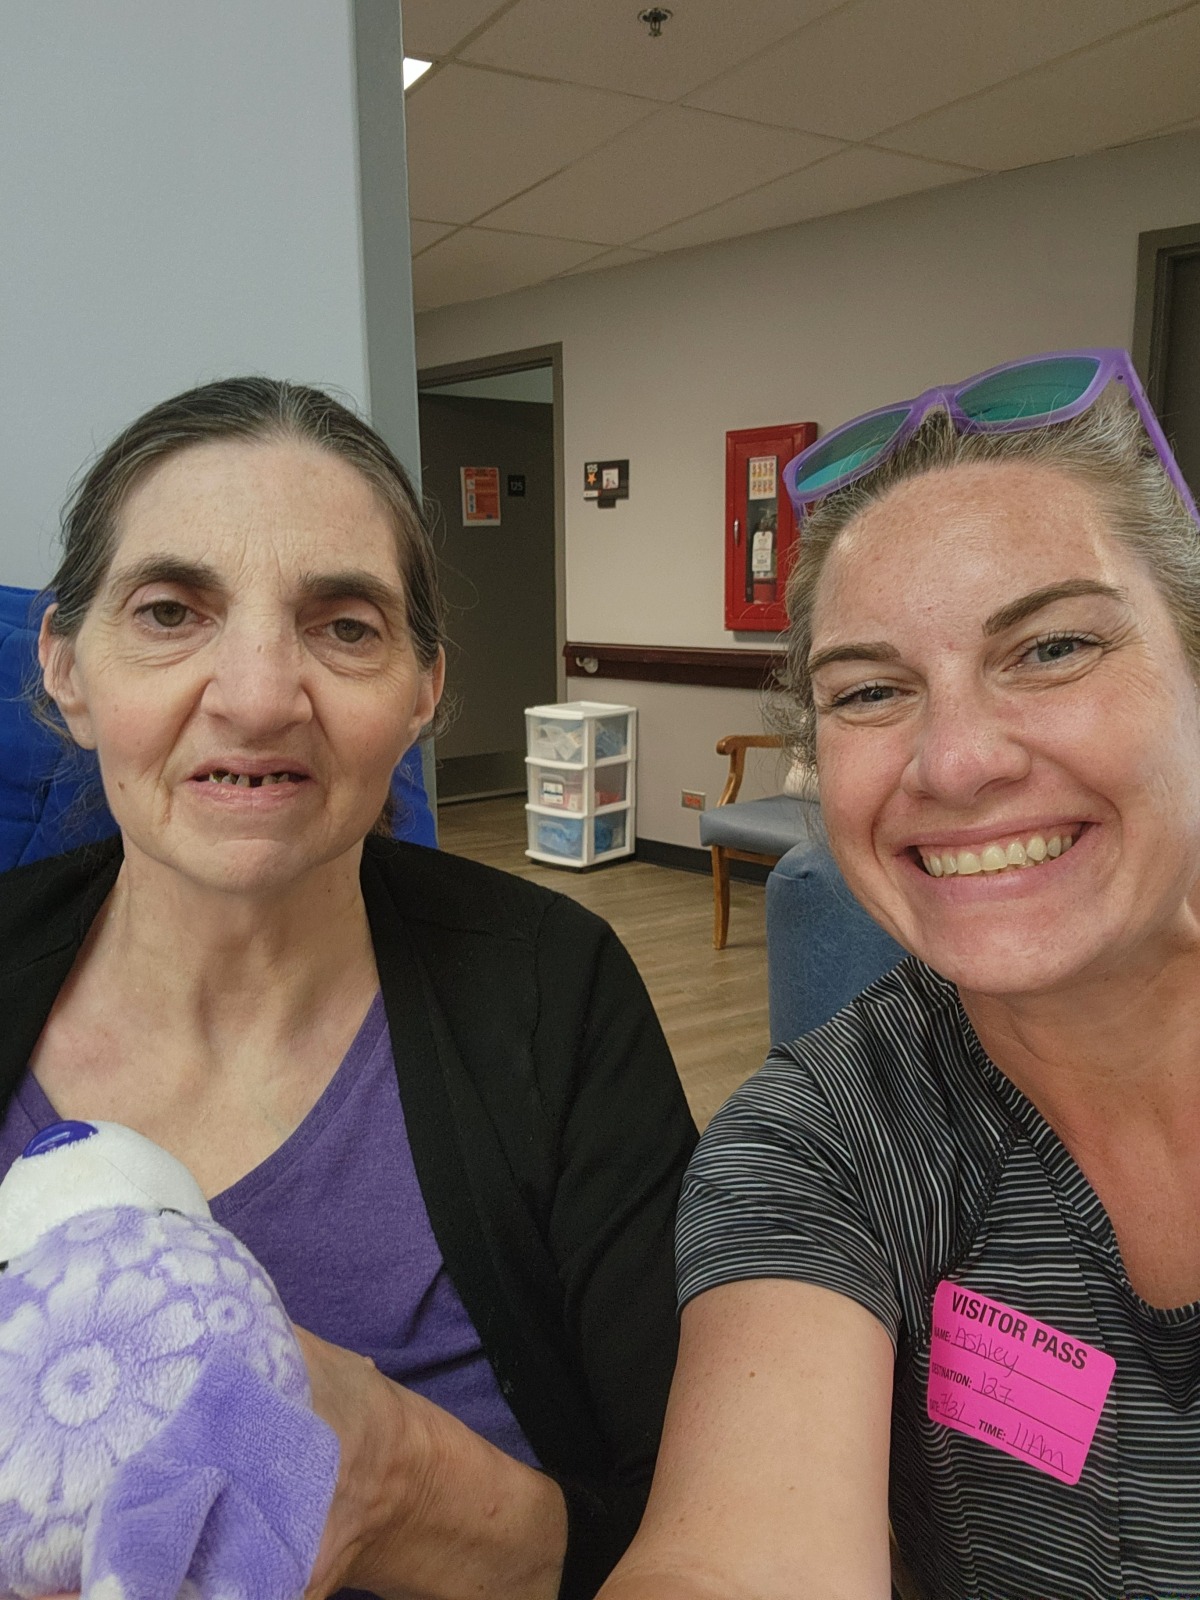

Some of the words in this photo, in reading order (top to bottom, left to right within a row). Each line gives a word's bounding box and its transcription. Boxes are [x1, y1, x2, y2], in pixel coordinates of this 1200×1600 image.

[952, 1291, 1028, 1341] VISITOR
[1031, 1328, 1088, 1370] PASS
[931, 1362, 972, 1388] DESTINATION:
[981, 1372, 1014, 1404] 127
[978, 1419, 1006, 1441] TIME:
